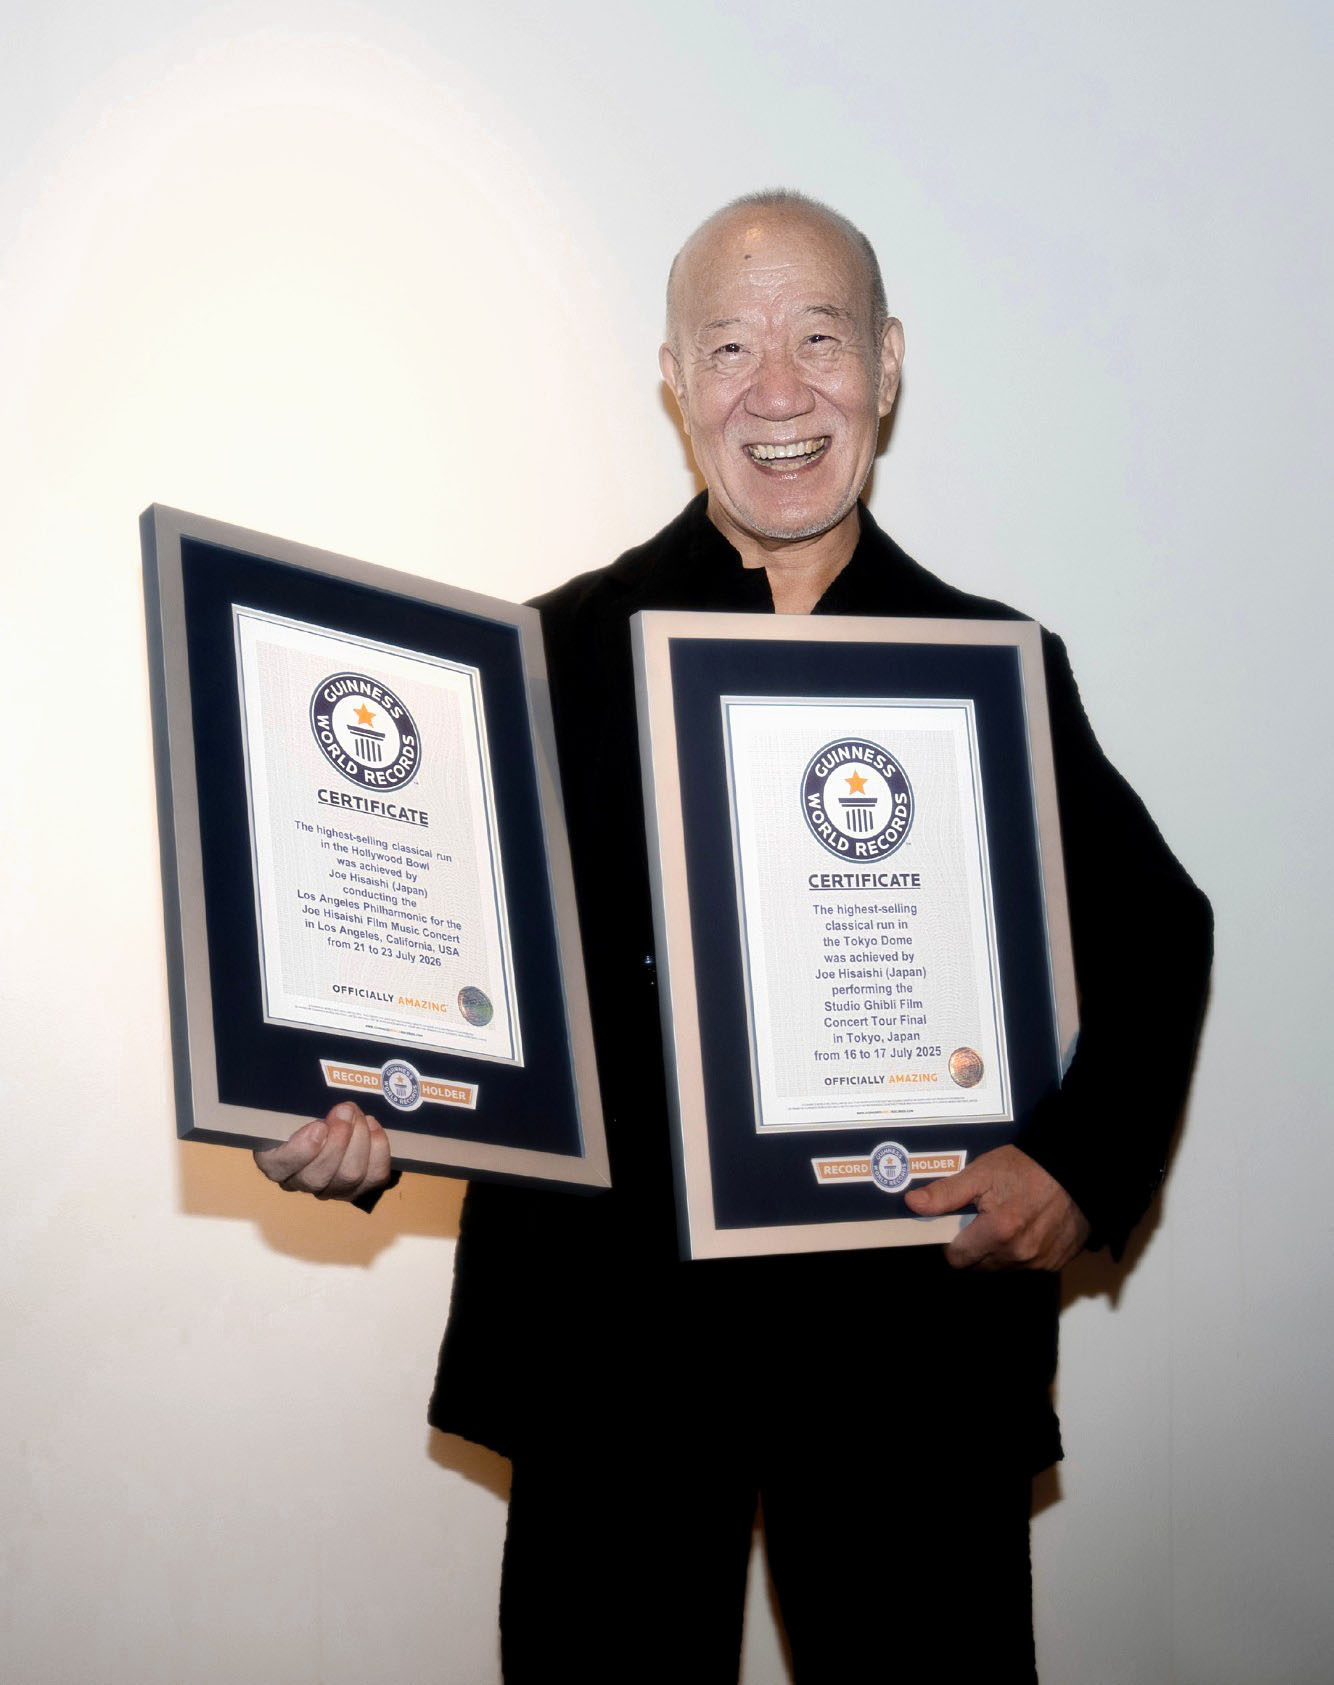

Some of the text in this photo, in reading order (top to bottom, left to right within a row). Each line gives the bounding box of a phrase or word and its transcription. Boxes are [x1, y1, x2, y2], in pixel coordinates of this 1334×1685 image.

[324, 680, 403, 719] GUINNESS
[317, 715, 414, 785] WORLD RECORDS
[815, 746, 896, 778] GUINNESS
[318, 789, 428, 825] CERTIFICATE
[807, 793, 907, 856] WORLD RECORDS
[295, 820, 452, 862] The highest-selling classical run
[321, 840, 429, 870] in the Hollywood Bowl
[337, 858, 417, 882] was achieved by
[809, 874, 921, 888] CERTIFICATE
[329, 869, 428, 898] Joe Hisaishi (Japan)
[343, 886, 416, 908] conducting the
[298, 889, 462, 930] Los Angeles Philharmonic for the
[813, 904, 917, 916] The highest-selling
[302, 905, 460, 943] Joe Hisaishi Film Music Concert
[825, 920, 908, 931] classical run in
[305, 919, 460, 957] in Los Angeles, California, USA
[823, 936, 912, 948] the Tokyo Dome
[328, 937, 441, 967] from 21 to 23 July 2026
[824, 951, 914, 963] was achieved by
[815, 967, 926, 980] Joe Hisaishi (Japan)
[333, 985, 448, 1013] OFFICIALLY AMAZING
[832, 983, 912, 996] performing the
[825, 999, 923, 1012] Studio Ghibli Film
[824, 1015, 927, 1027] Concert Tour Final
[833, 1032, 920, 1044] in Tokyo, Japan
[814, 1046, 941, 1061] from 16 to 17 July 2025
[333, 1071, 466, 1100] RECORD HOLDER
[824, 1073, 938, 1086] OFFICIALLY AMAZING
[824, 1160, 955, 1175] RECORD HOLDER
